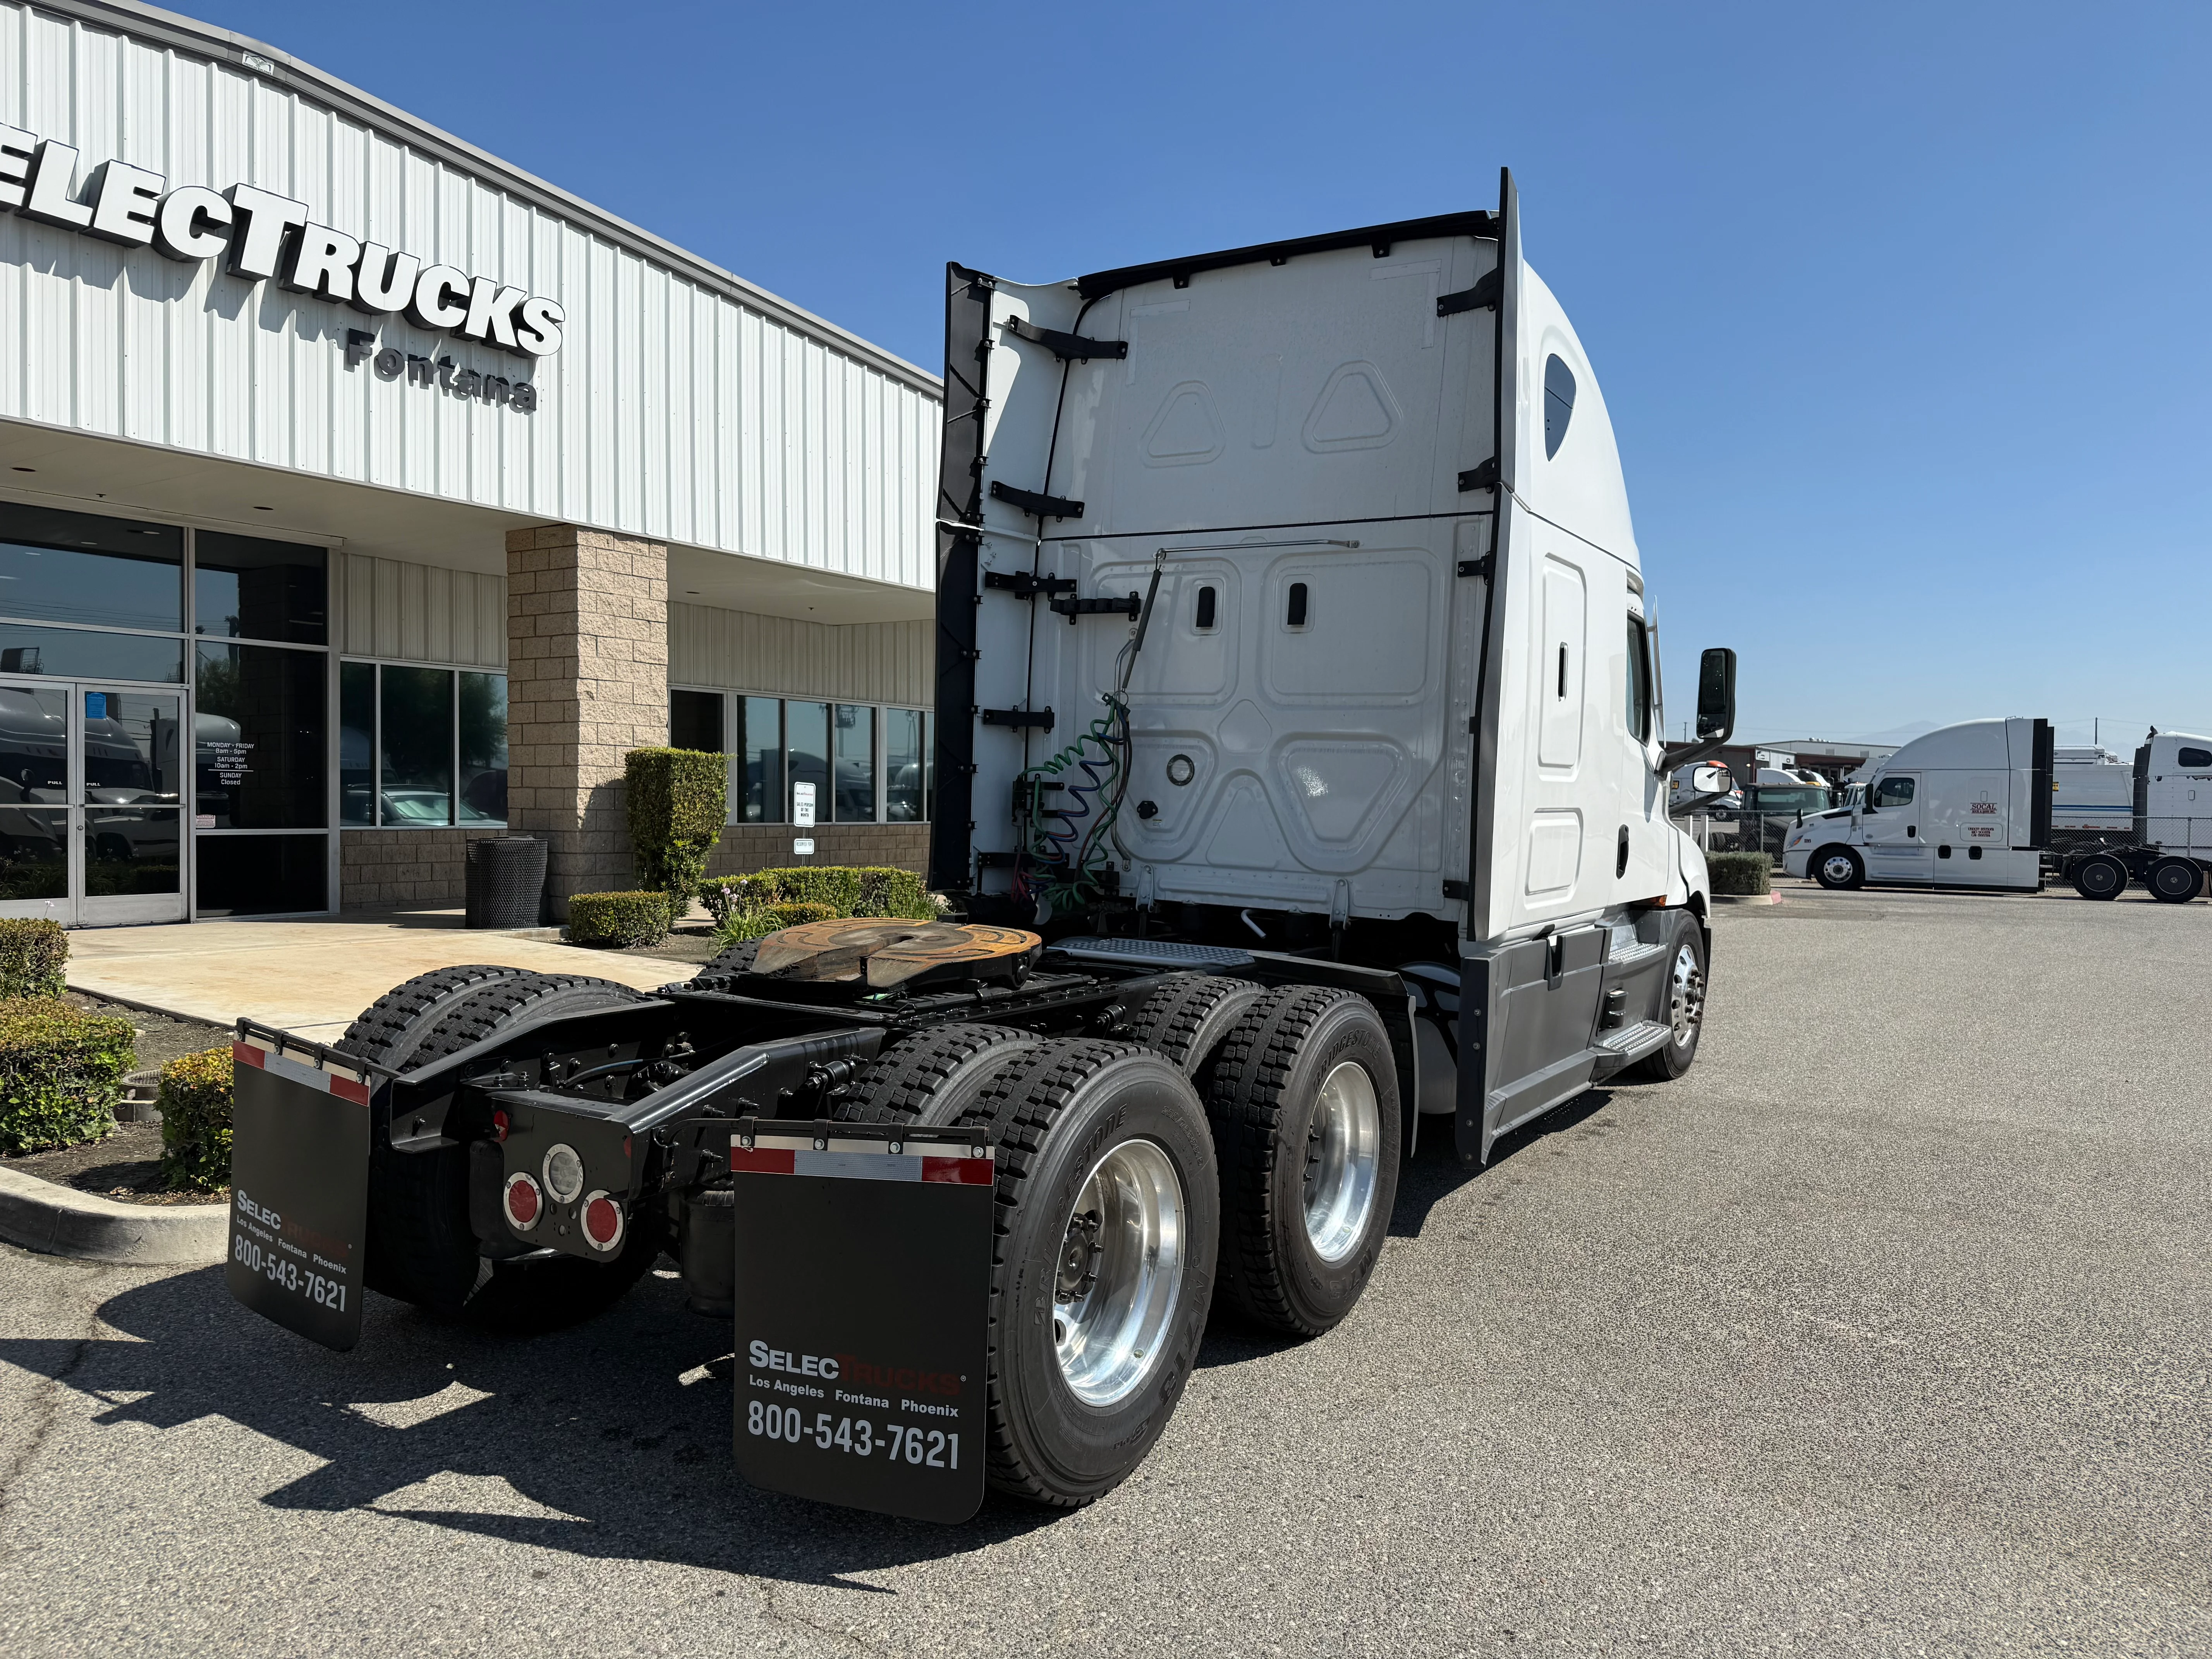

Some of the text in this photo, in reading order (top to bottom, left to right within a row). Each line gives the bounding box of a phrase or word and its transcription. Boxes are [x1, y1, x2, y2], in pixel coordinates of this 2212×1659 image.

[348, 328, 537, 411] Fontana
[1313, 1029, 1382, 1096] BRIDGESTONE
[237, 1214, 347, 1274] Los Angeles Fontana Phoenix
[1034, 1103, 1127, 1327] BRIDGESTONE
[235, 1235, 346, 1312] 800-543-7621
[749, 1374, 958, 1417] Los Angeles Fontana Phoenix
[748, 1401, 958, 1469] 800-543-7621
